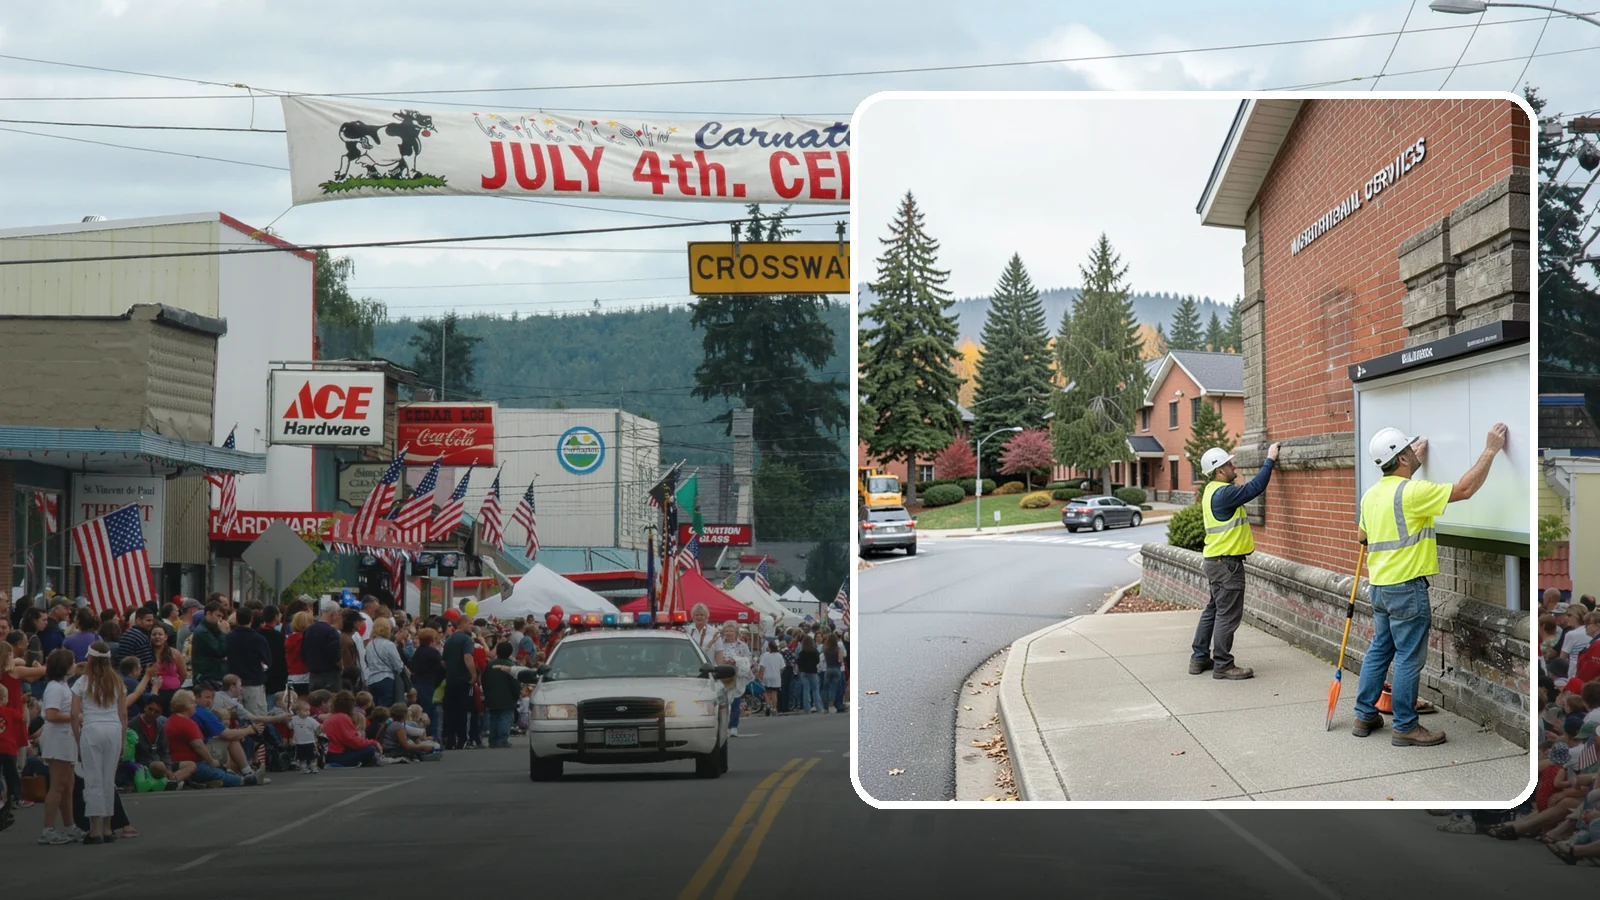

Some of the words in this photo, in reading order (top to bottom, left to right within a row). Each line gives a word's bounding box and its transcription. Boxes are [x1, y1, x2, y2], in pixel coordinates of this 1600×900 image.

[481, 141, 605, 192] JULY
[632, 150, 747, 198] 4th.
[697, 254, 850, 280] CROSSWA
[283, 380, 373, 420] ACE
[406, 409, 452, 422] CEDAR
[461, 409, 485, 421] LOG
[283, 421, 371, 436] Hardware
[354, 467, 386, 481] Simpl
[95, 485, 123, 494] Vincent
[126, 486, 135, 494] de
[137, 486, 155, 495] Paul
[699, 535, 730, 544] GLASS
